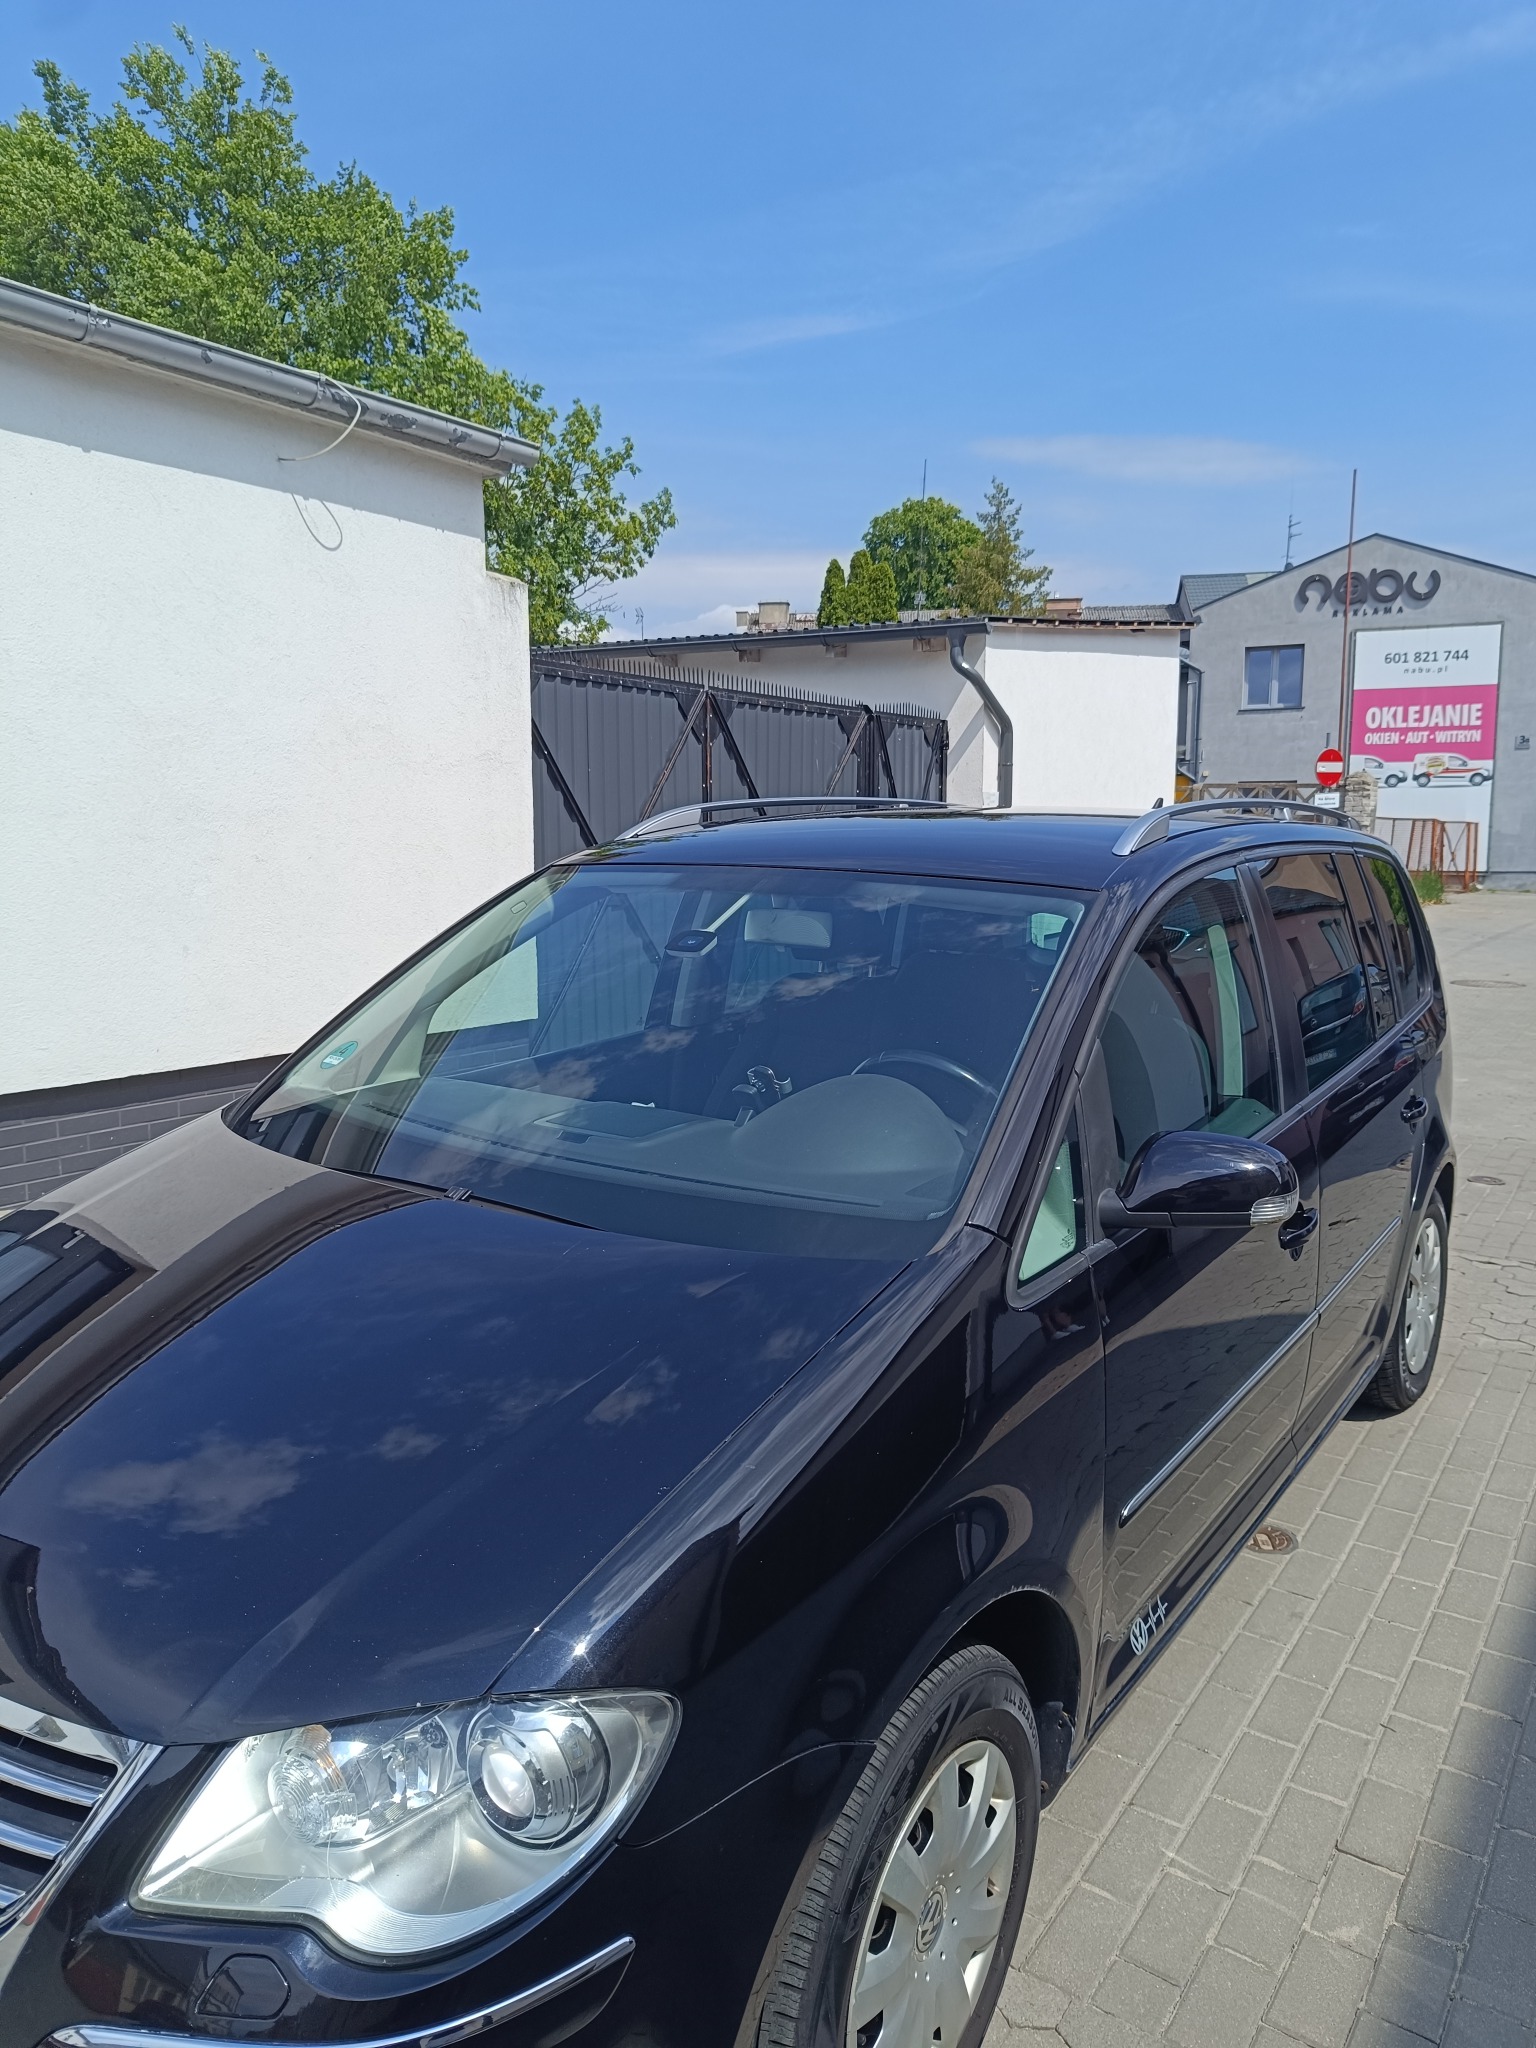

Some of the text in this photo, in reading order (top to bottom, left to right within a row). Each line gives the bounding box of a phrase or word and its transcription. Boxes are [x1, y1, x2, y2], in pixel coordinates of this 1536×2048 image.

[1384, 649, 1469, 664] 601 821 744
[1403, 665, 1448, 674] nabu.pl
[1365, 703, 1483, 728] OKLEJANIE
[1364, 729, 1482, 745] OKIEN AUT WITRYN
[1003, 1687, 1017, 1707] ALL
